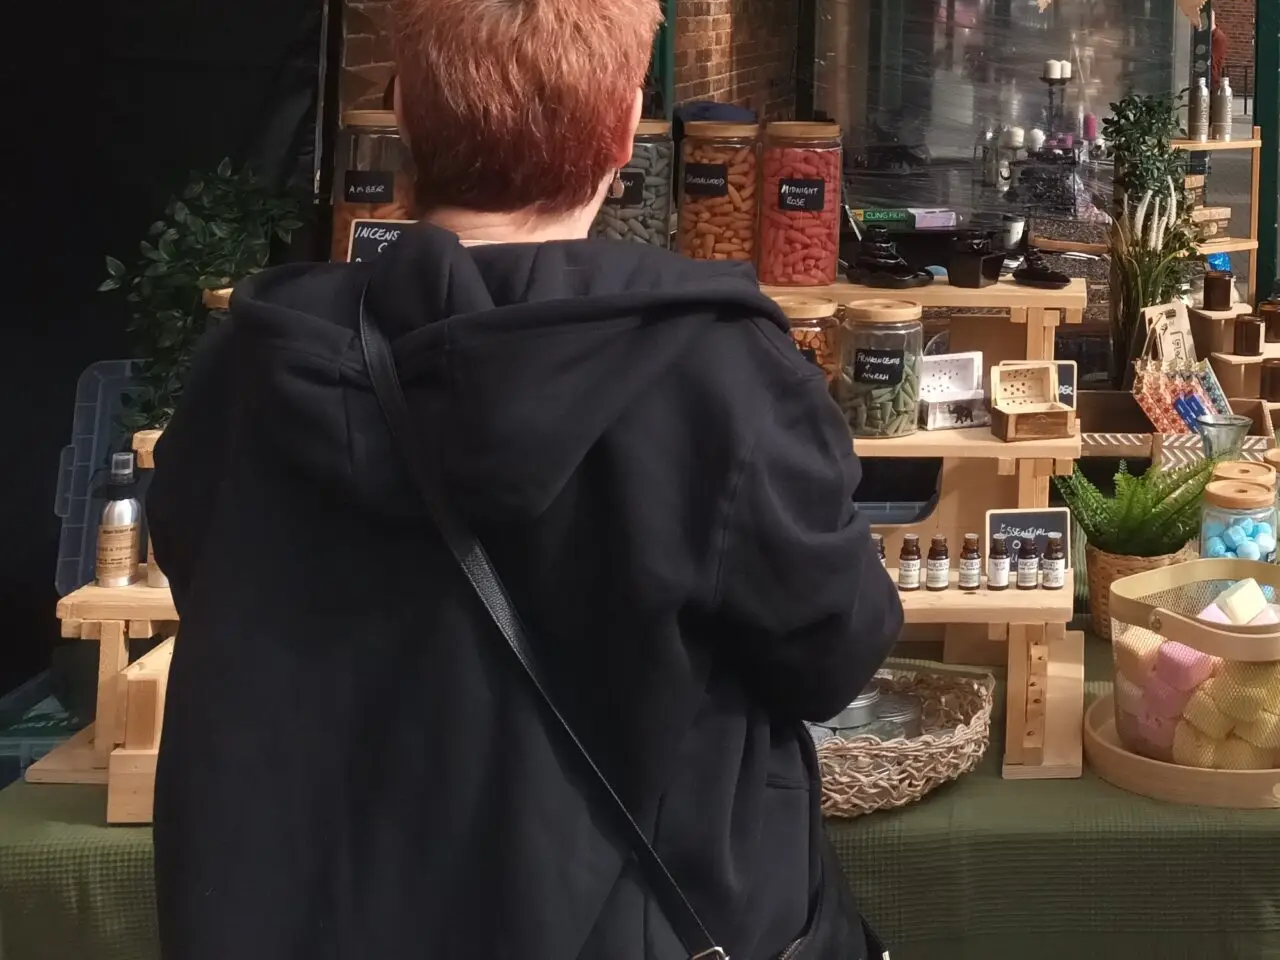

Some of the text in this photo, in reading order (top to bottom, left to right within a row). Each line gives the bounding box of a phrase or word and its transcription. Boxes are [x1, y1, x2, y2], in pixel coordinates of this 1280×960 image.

[349, 185, 385, 194] AMBER
[781, 184, 818, 195] MIDNIGHT
[786, 196, 805, 206] ROSE
[865, 211, 906, 219] CLING FILM
[354, 227, 401, 241] INCENS
[862, 371, 889, 381] MYRRH
[1001, 523, 1048, 537] ESSENTIAL
